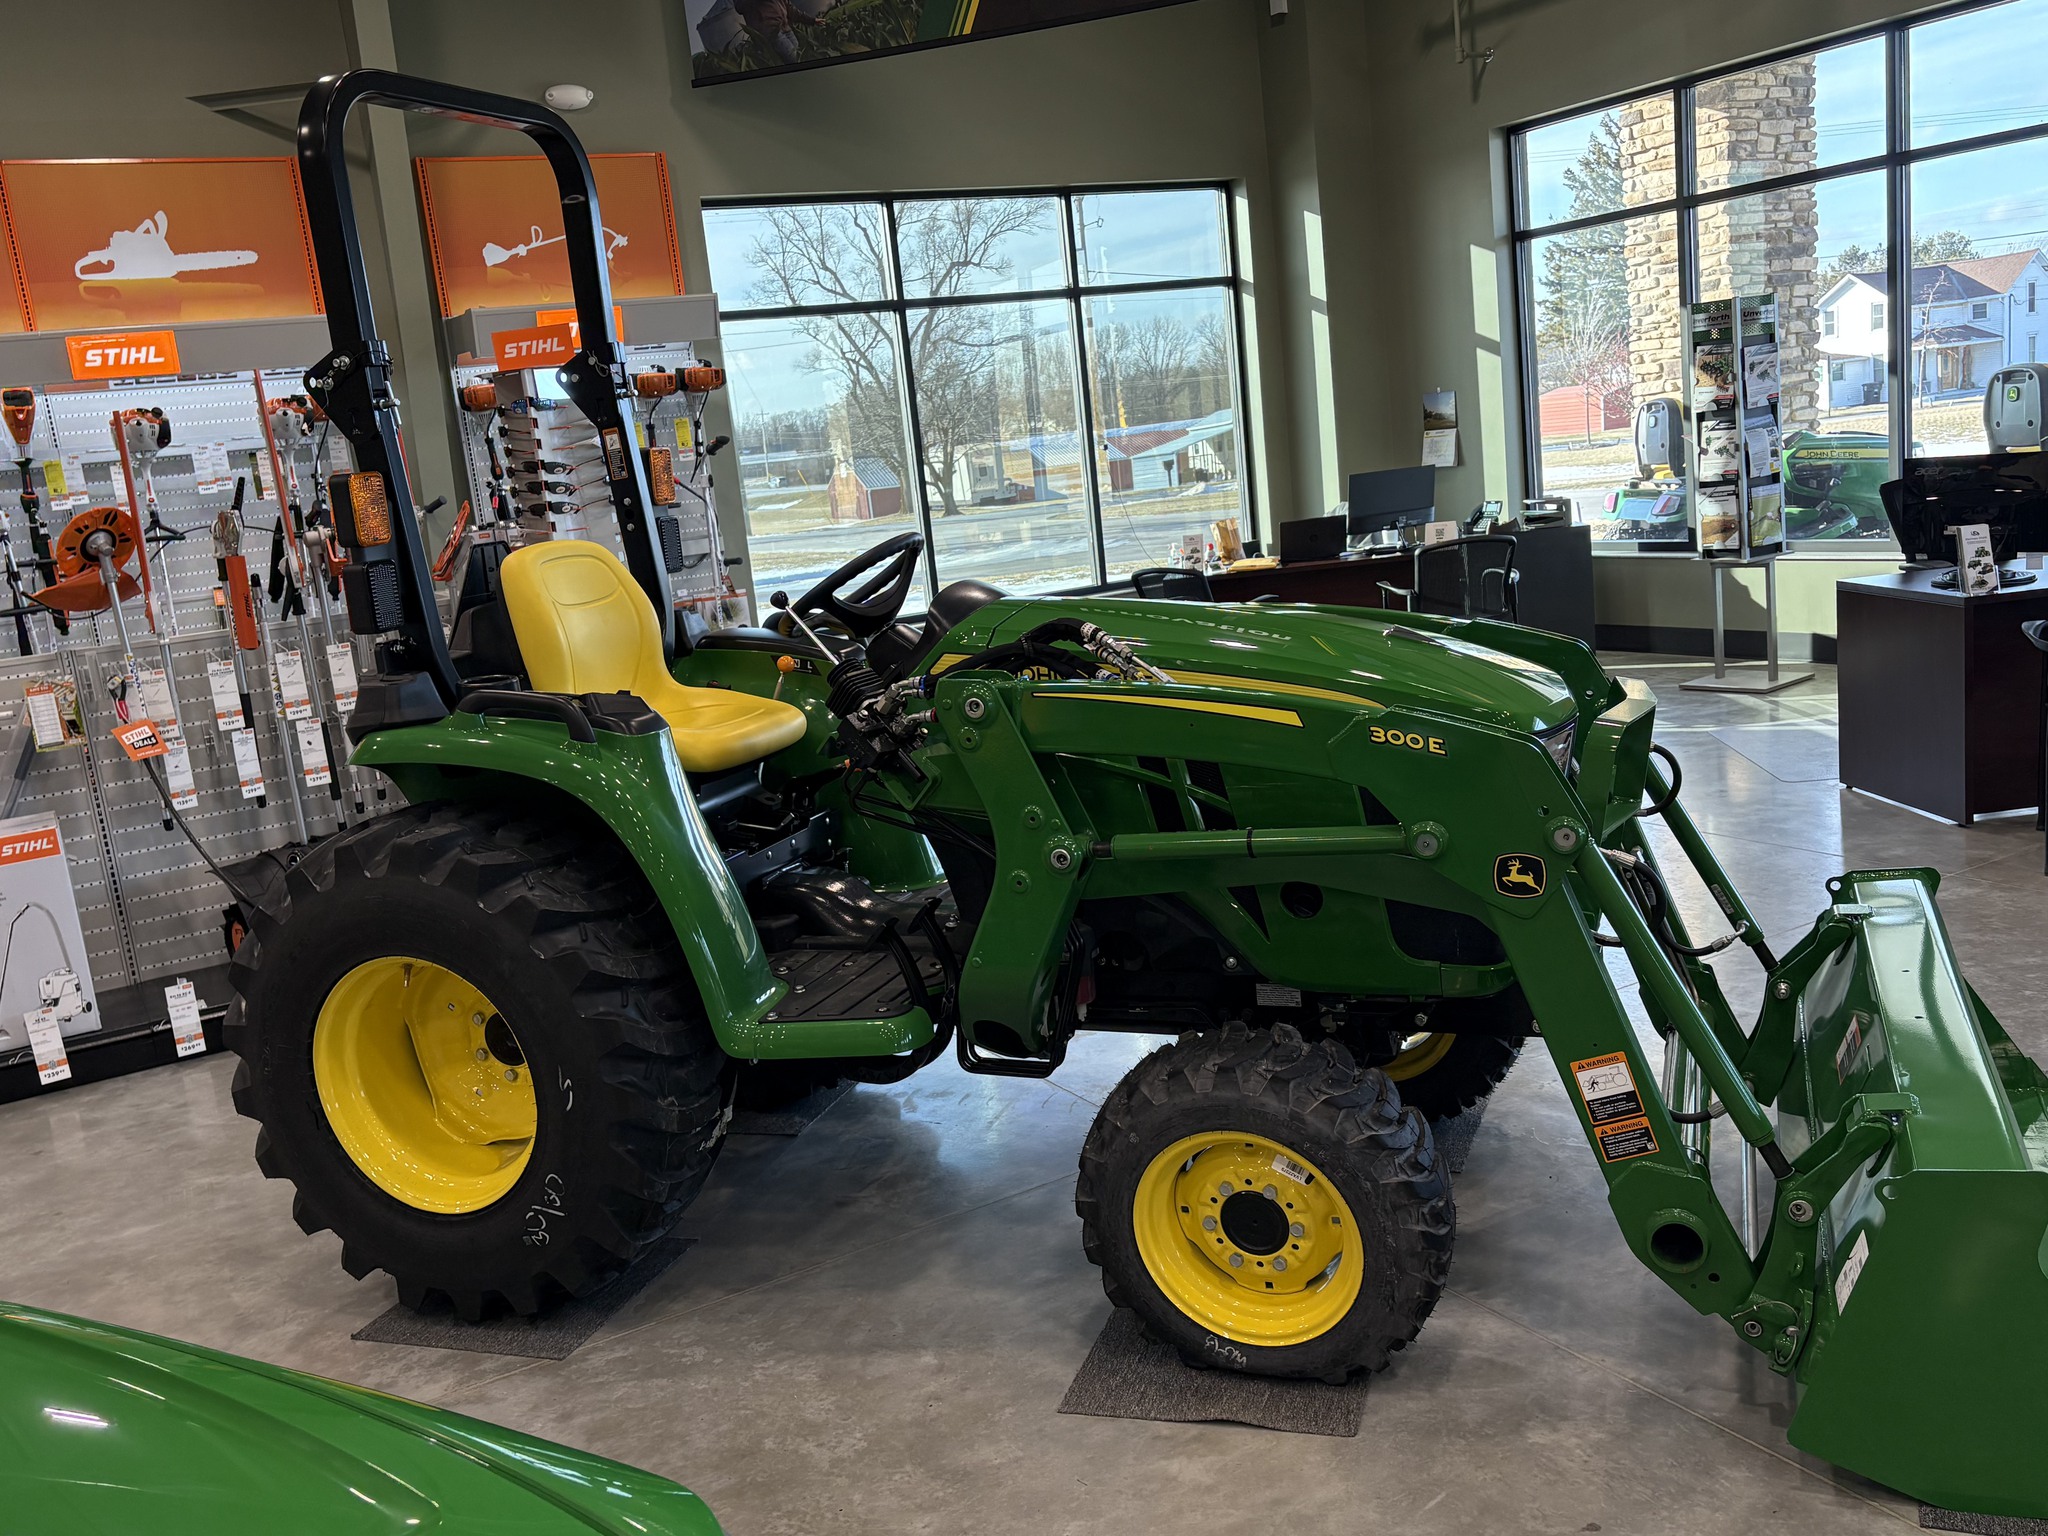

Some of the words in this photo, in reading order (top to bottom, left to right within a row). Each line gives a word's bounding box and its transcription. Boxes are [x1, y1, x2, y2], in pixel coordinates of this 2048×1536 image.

[503, 337, 566, 359] STIHL
[84, 345, 165, 368] STIHL
[1804, 450, 1829, 459] JOHN
[1830, 450, 1859, 459] DEERE
[1914, 465, 1944, 476] acer
[124, 727, 150, 743] STIHL
[133, 736, 158, 749] DEALS
[1, 837, 54, 857] STIHL
[1585, 1055, 1620, 1068] WARNING
[1609, 1120, 1644, 1133] WARNING
